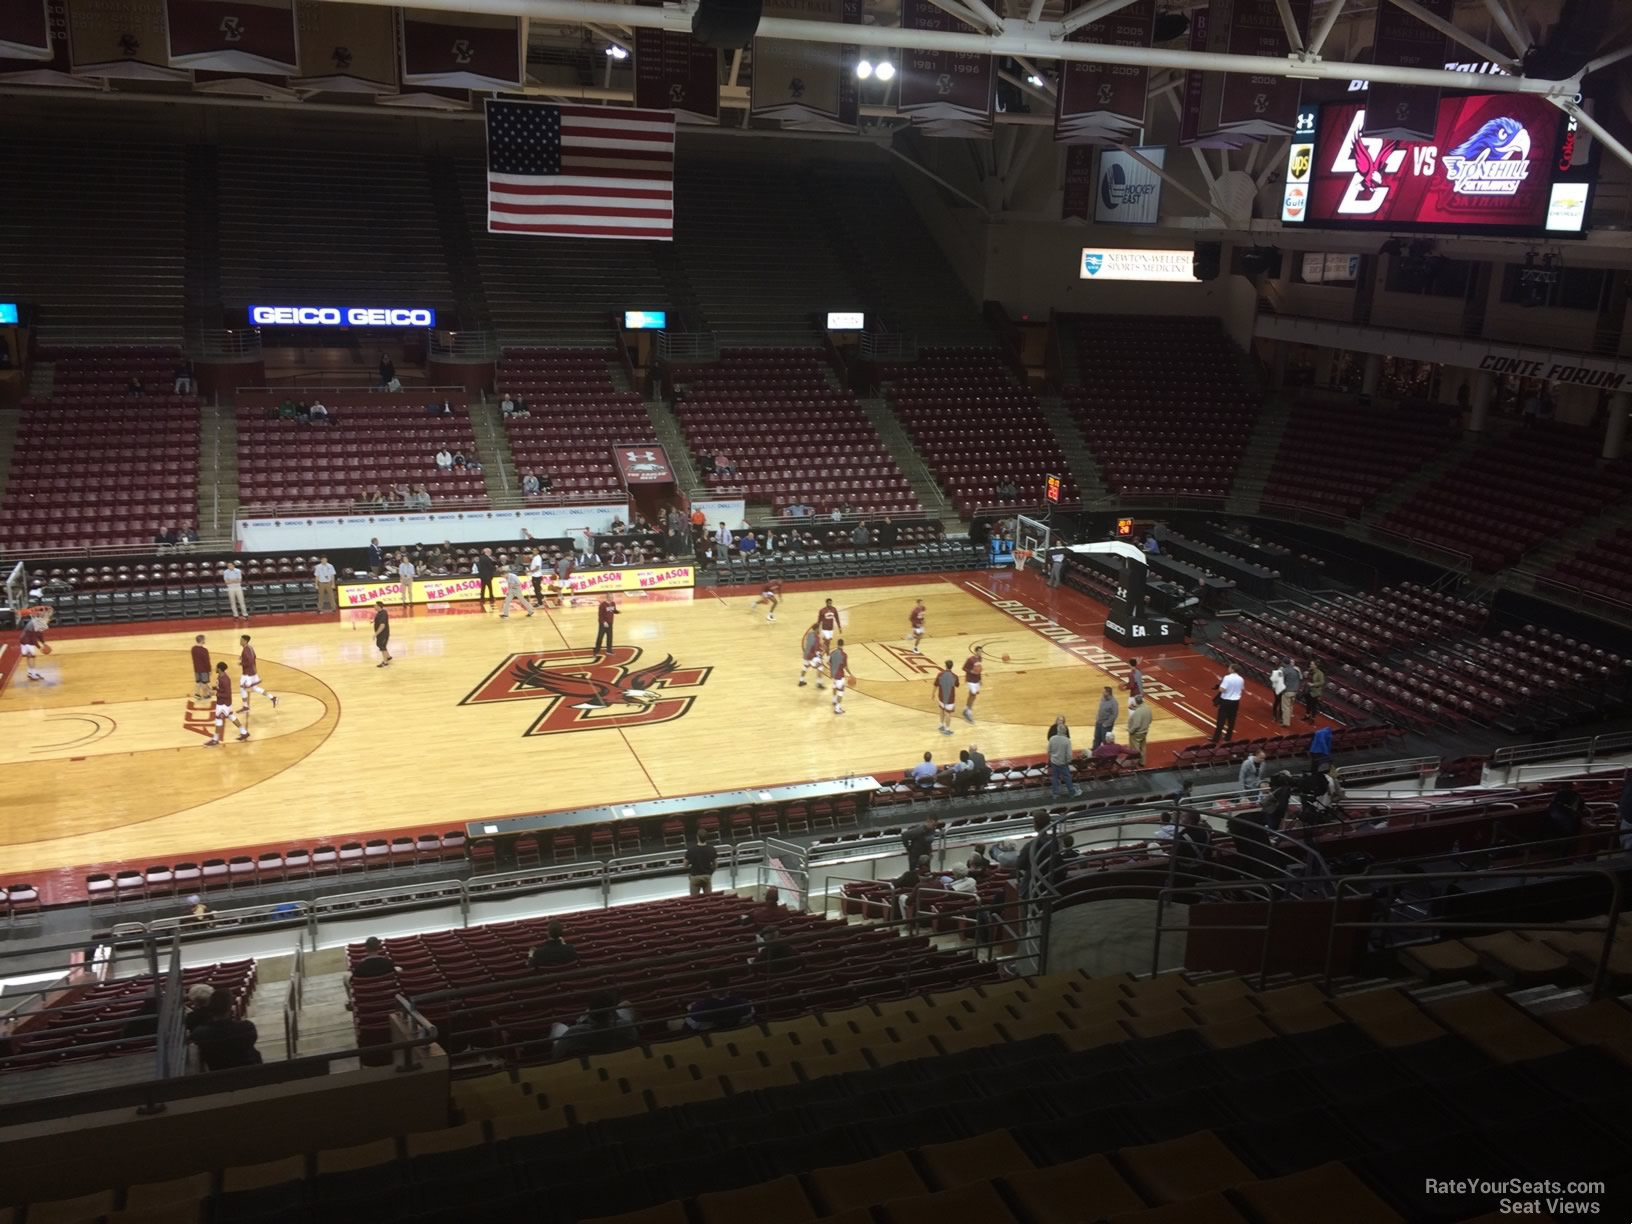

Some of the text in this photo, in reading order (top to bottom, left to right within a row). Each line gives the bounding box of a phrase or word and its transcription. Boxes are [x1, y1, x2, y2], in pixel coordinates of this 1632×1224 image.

[914, 17, 941, 27] 1967
[1116, 25, 1144, 35] 2005
[913, 60, 980, 74] 1981 1996
[1075, 63, 1140, 76] 2004 2009
[1251, 76, 1277, 85] 2006
[1559, 131, 1576, 171] Coke
[1291, 155, 1309, 176] ups
[1414, 146, 1437, 176] VS
[1448, 158, 1528, 178] STONEHILL
[1124, 184, 1157, 195] HOCKEY
[1122, 194, 1141, 204] EAST
[1285, 197, 1305, 207] Gulf
[1107, 262, 1140, 272] SPORTS
[1142, 264, 1185, 273] MEDICINE
[1108, 254, 1190, 264] NEWTON-WELLESL
[253, 307, 431, 326] GEICO GEICO
[1479, 355, 1626, 389] CONTE FORUM
[571, 572, 622, 591] W.B.MASON
[640, 568, 689, 587] W.B.MASON
[348, 584, 403, 604] W.B.MASO
[992, 599, 1087, 644] BOSTON
[1105, 619, 1126, 636] GEICO
[881, 643, 946, 674] ACC
